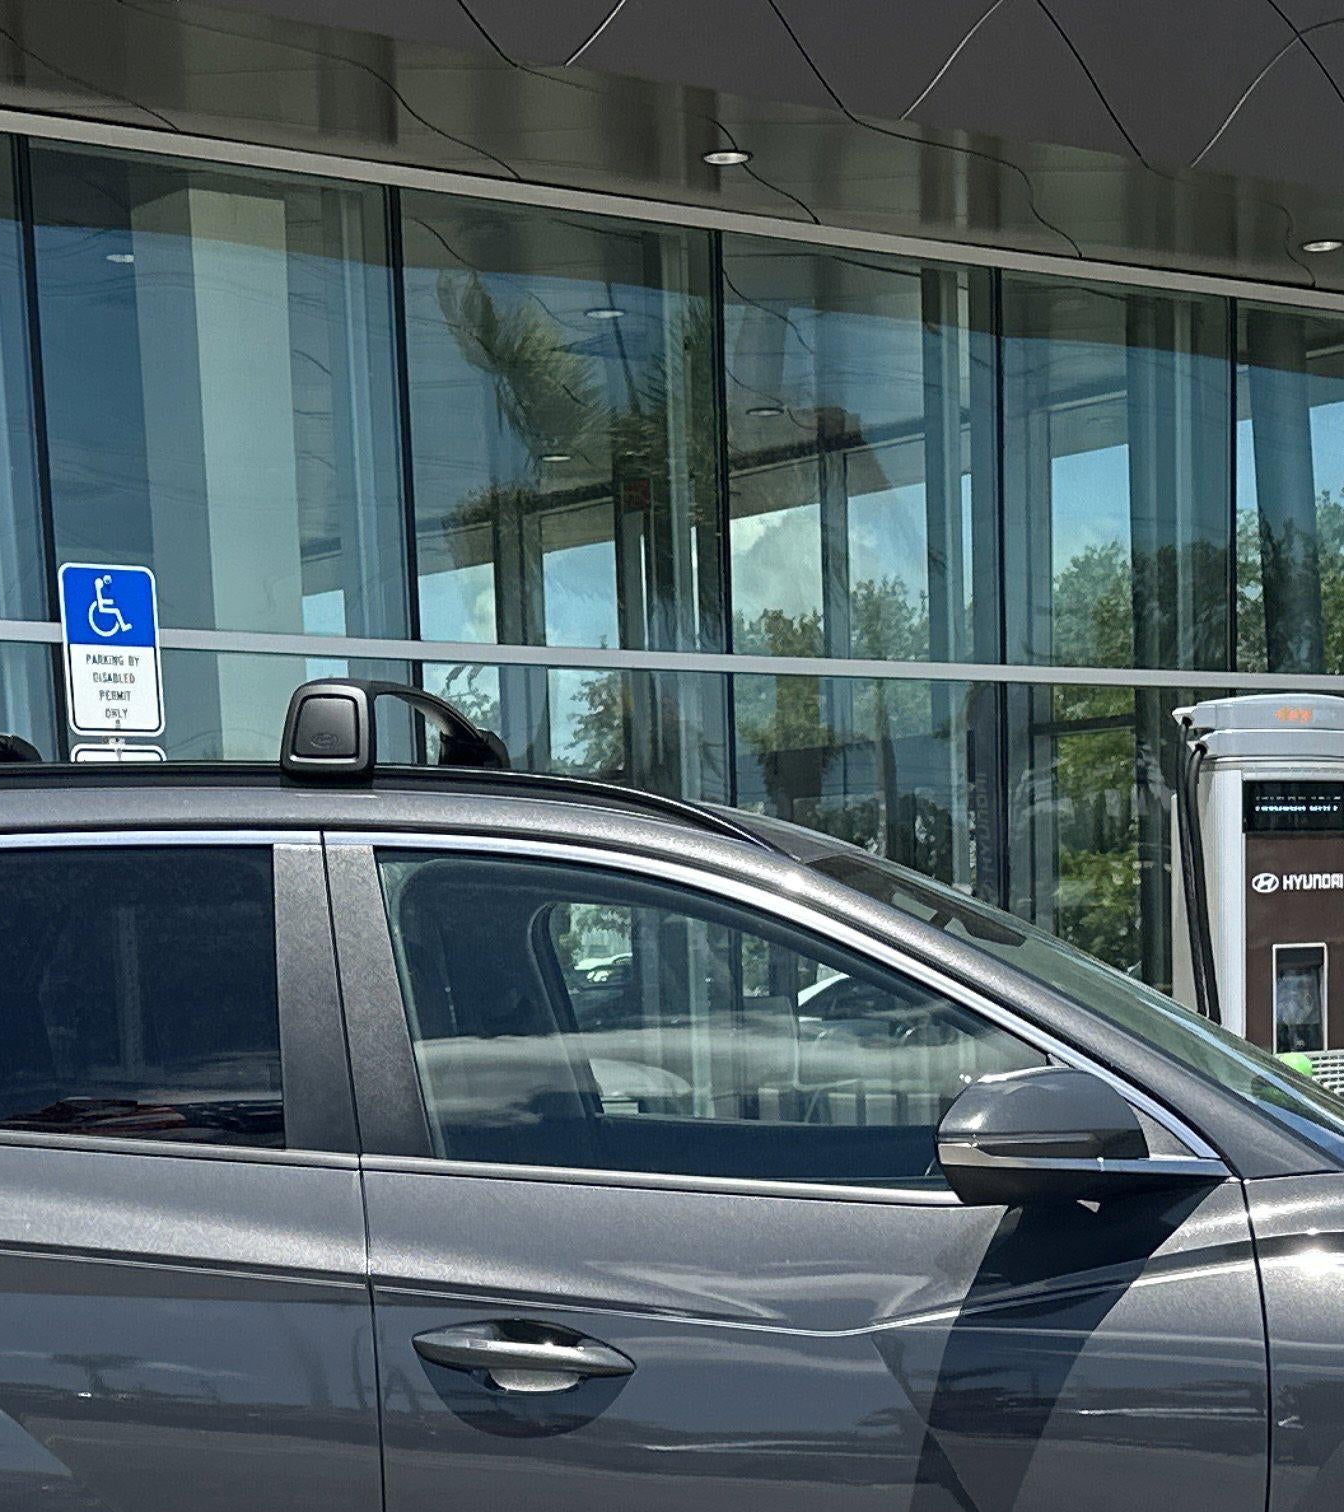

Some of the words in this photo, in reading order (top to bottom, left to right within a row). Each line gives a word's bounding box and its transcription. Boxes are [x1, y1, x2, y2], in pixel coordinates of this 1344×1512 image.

[86, 654, 124, 665] PARKING
[128, 655, 139, 667] BY
[93, 672, 136, 683] DISABLED
[98, 690, 131, 701] PERMIT
[105, 708, 128, 719] ONLY
[1282, 873, 1344, 891] HYUNDAI
